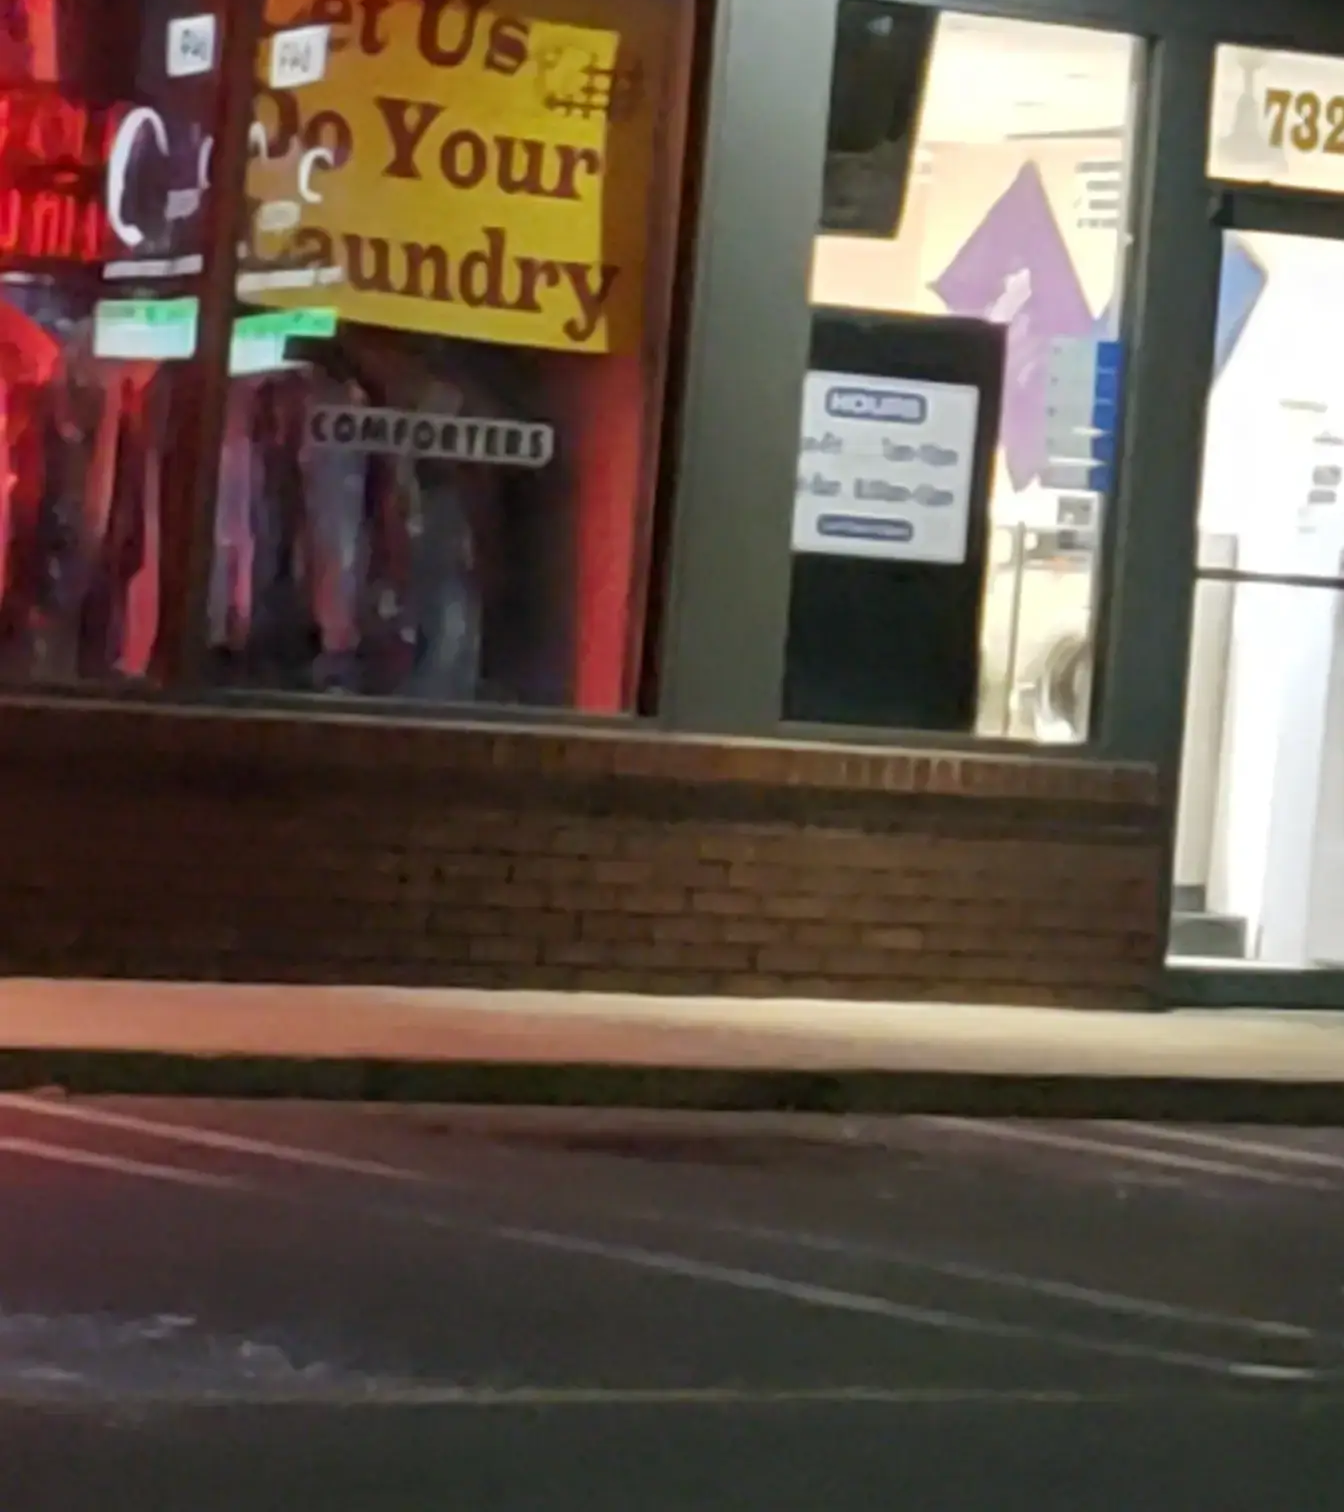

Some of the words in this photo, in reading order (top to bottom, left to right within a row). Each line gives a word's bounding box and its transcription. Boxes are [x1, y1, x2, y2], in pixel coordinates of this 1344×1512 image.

[374, 96, 600, 201] Your
[256, 218, 621, 342] aundry
[311, 410, 545, 459] COMFORTERS
